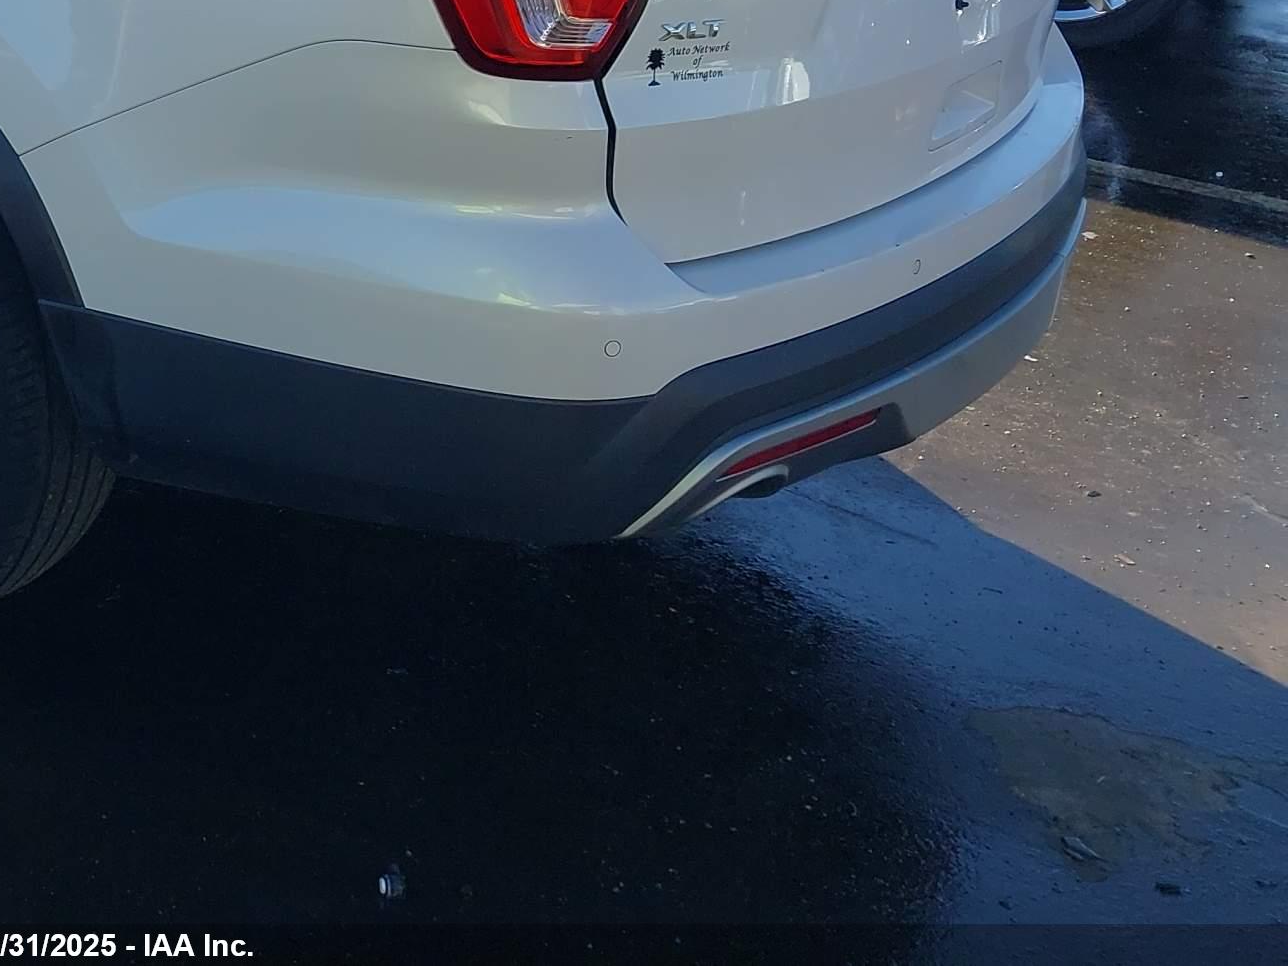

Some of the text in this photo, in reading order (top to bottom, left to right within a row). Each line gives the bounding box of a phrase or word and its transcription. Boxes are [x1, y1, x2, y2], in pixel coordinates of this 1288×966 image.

[659, 19, 728, 41] XLT
[667, 42, 730, 56] Auto Network
[693, 56, 702, 68] of
[671, 69, 723, 81] Wilmington
